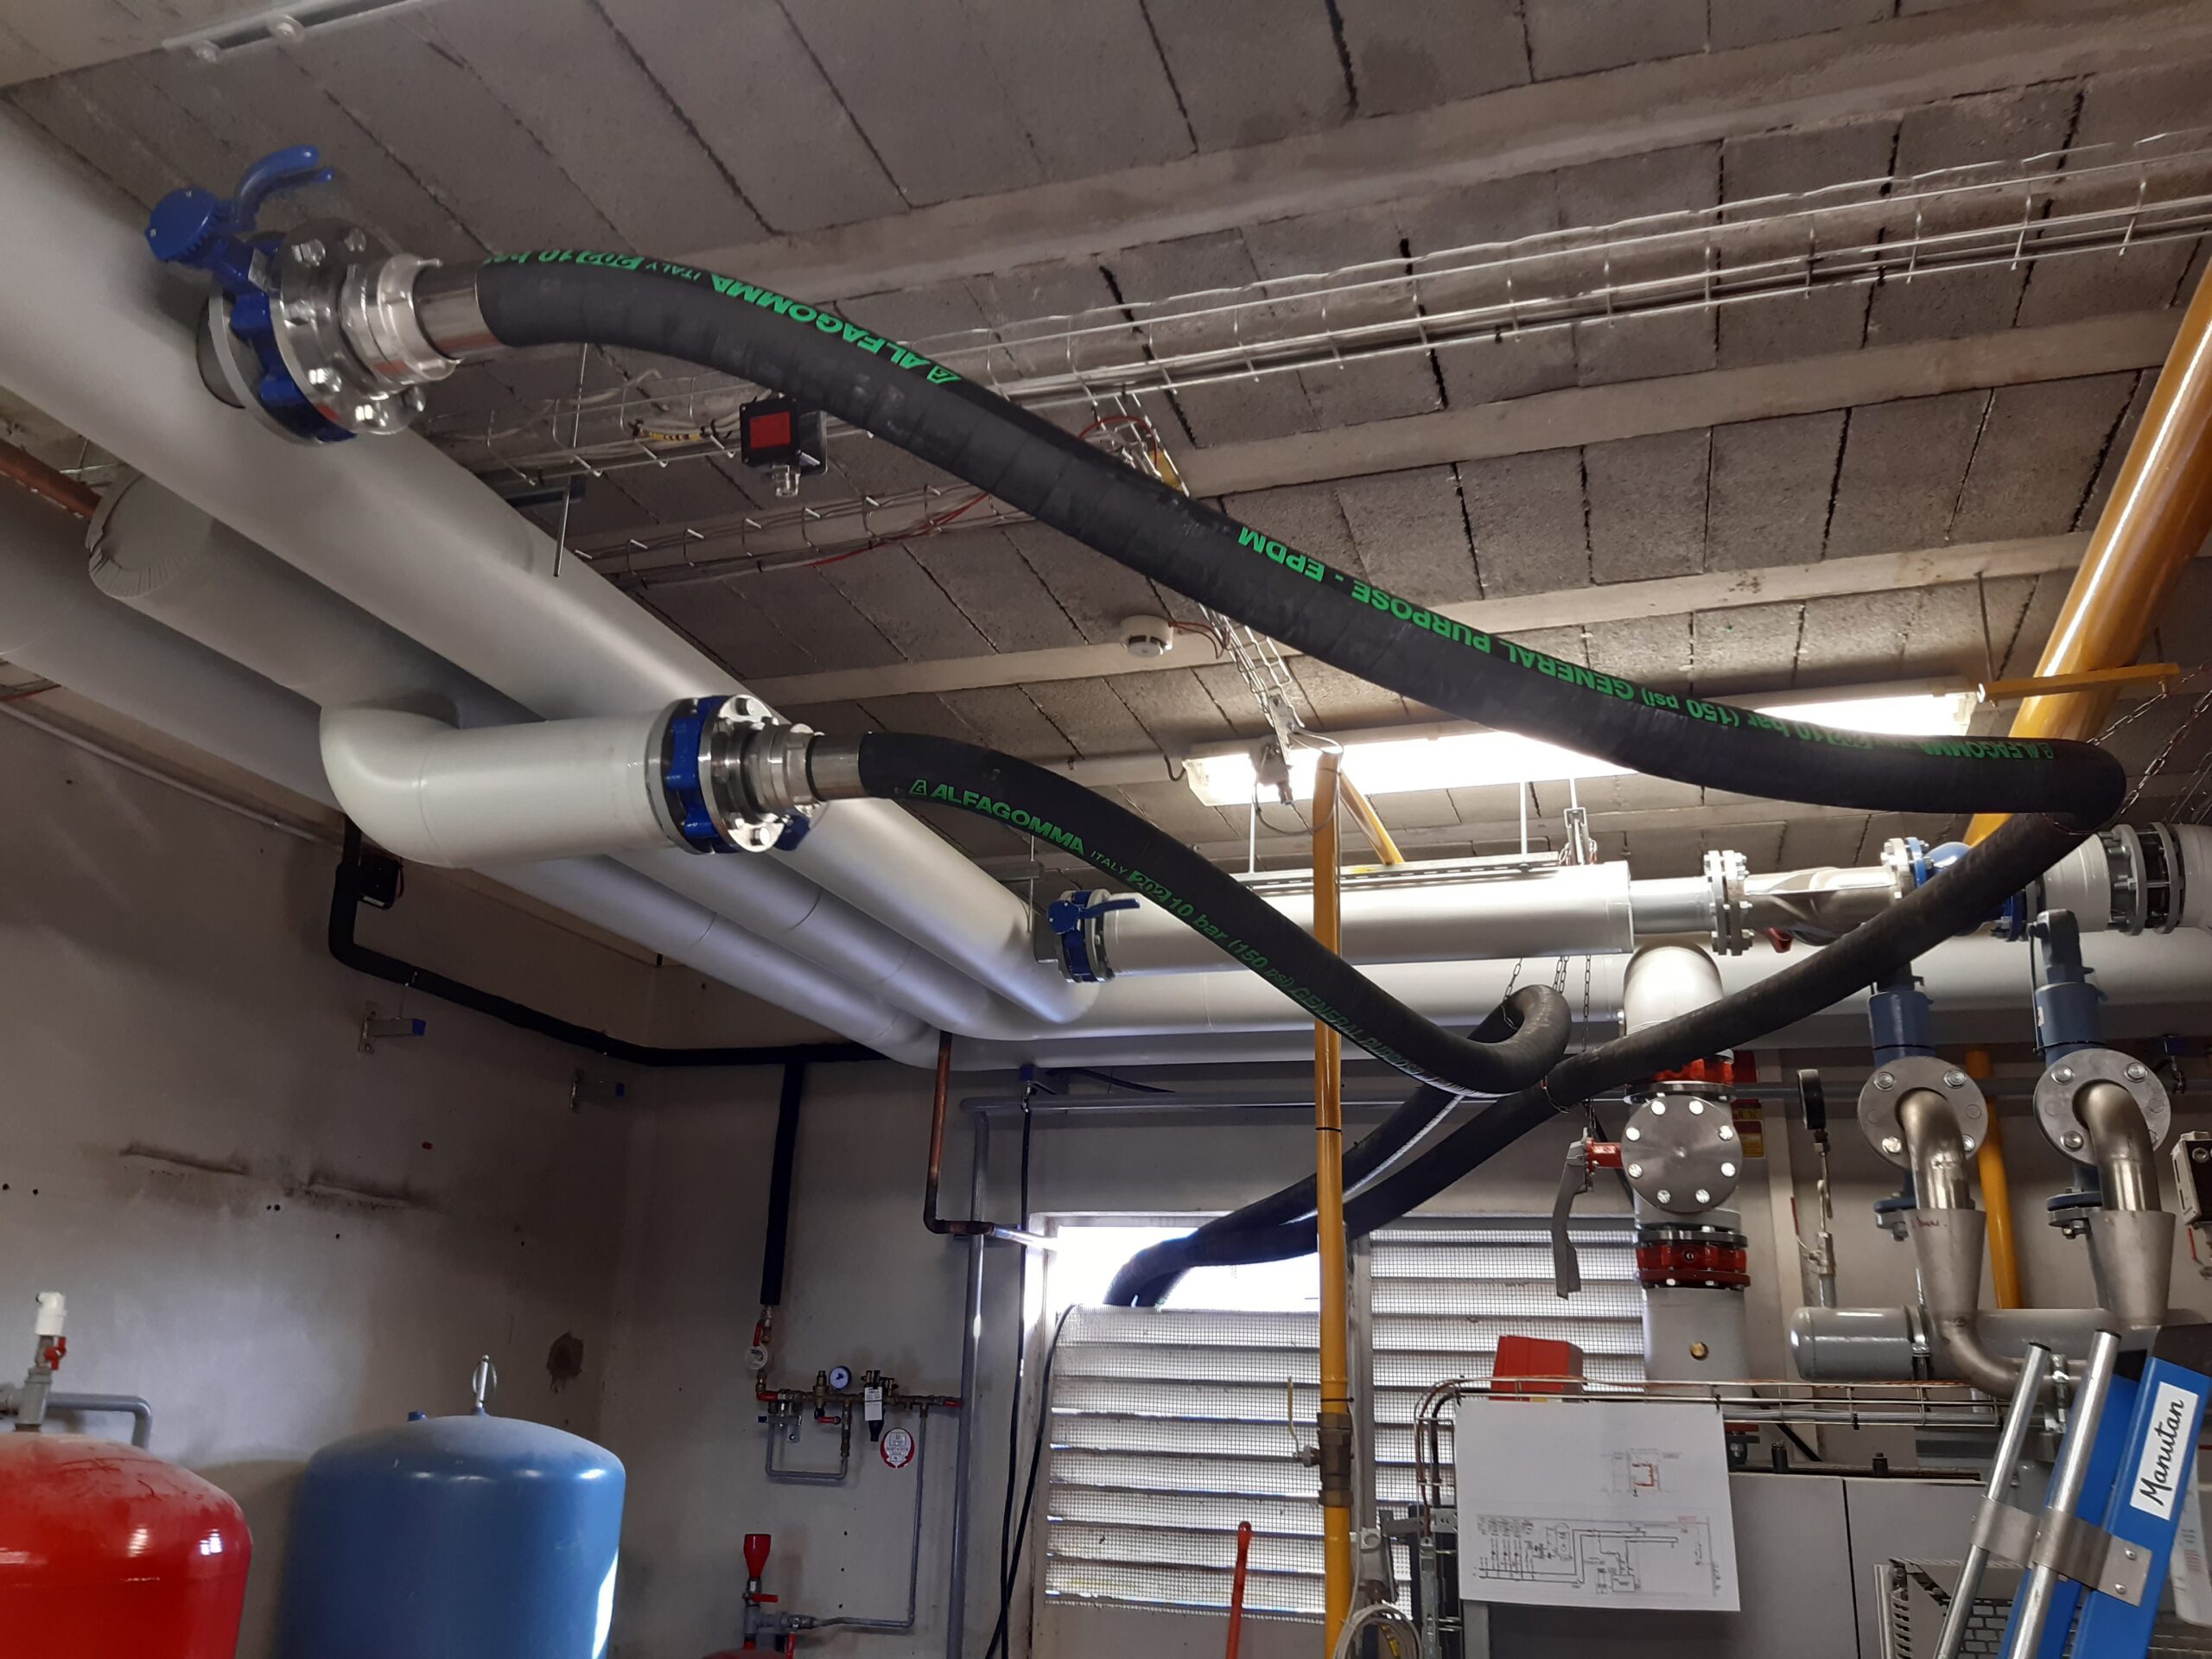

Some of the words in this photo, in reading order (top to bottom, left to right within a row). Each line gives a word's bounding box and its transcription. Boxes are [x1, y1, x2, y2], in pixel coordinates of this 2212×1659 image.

[645, 262, 702, 281] ITALY
[711, 273, 931, 369] ALFAGOMMA
[1238, 526, 1325, 582] EPDM
[1351, 580, 1492, 654] PURPOSE
[1499, 639, 1636, 700] GENERAL
[1641, 687, 1680, 709] psi)
[1686, 699, 1740, 727] (150
[1748, 711, 1789, 737] bar
[931, 783, 1084, 855] ALFAGOMMA
[1090, 850, 1128, 874] ITALY
[1168, 898, 1194, 917] 10
[1193, 913, 1229, 939] bar
[1228, 939, 1269, 969] (150
[2139, 1399, 2184, 1507] Manutan
